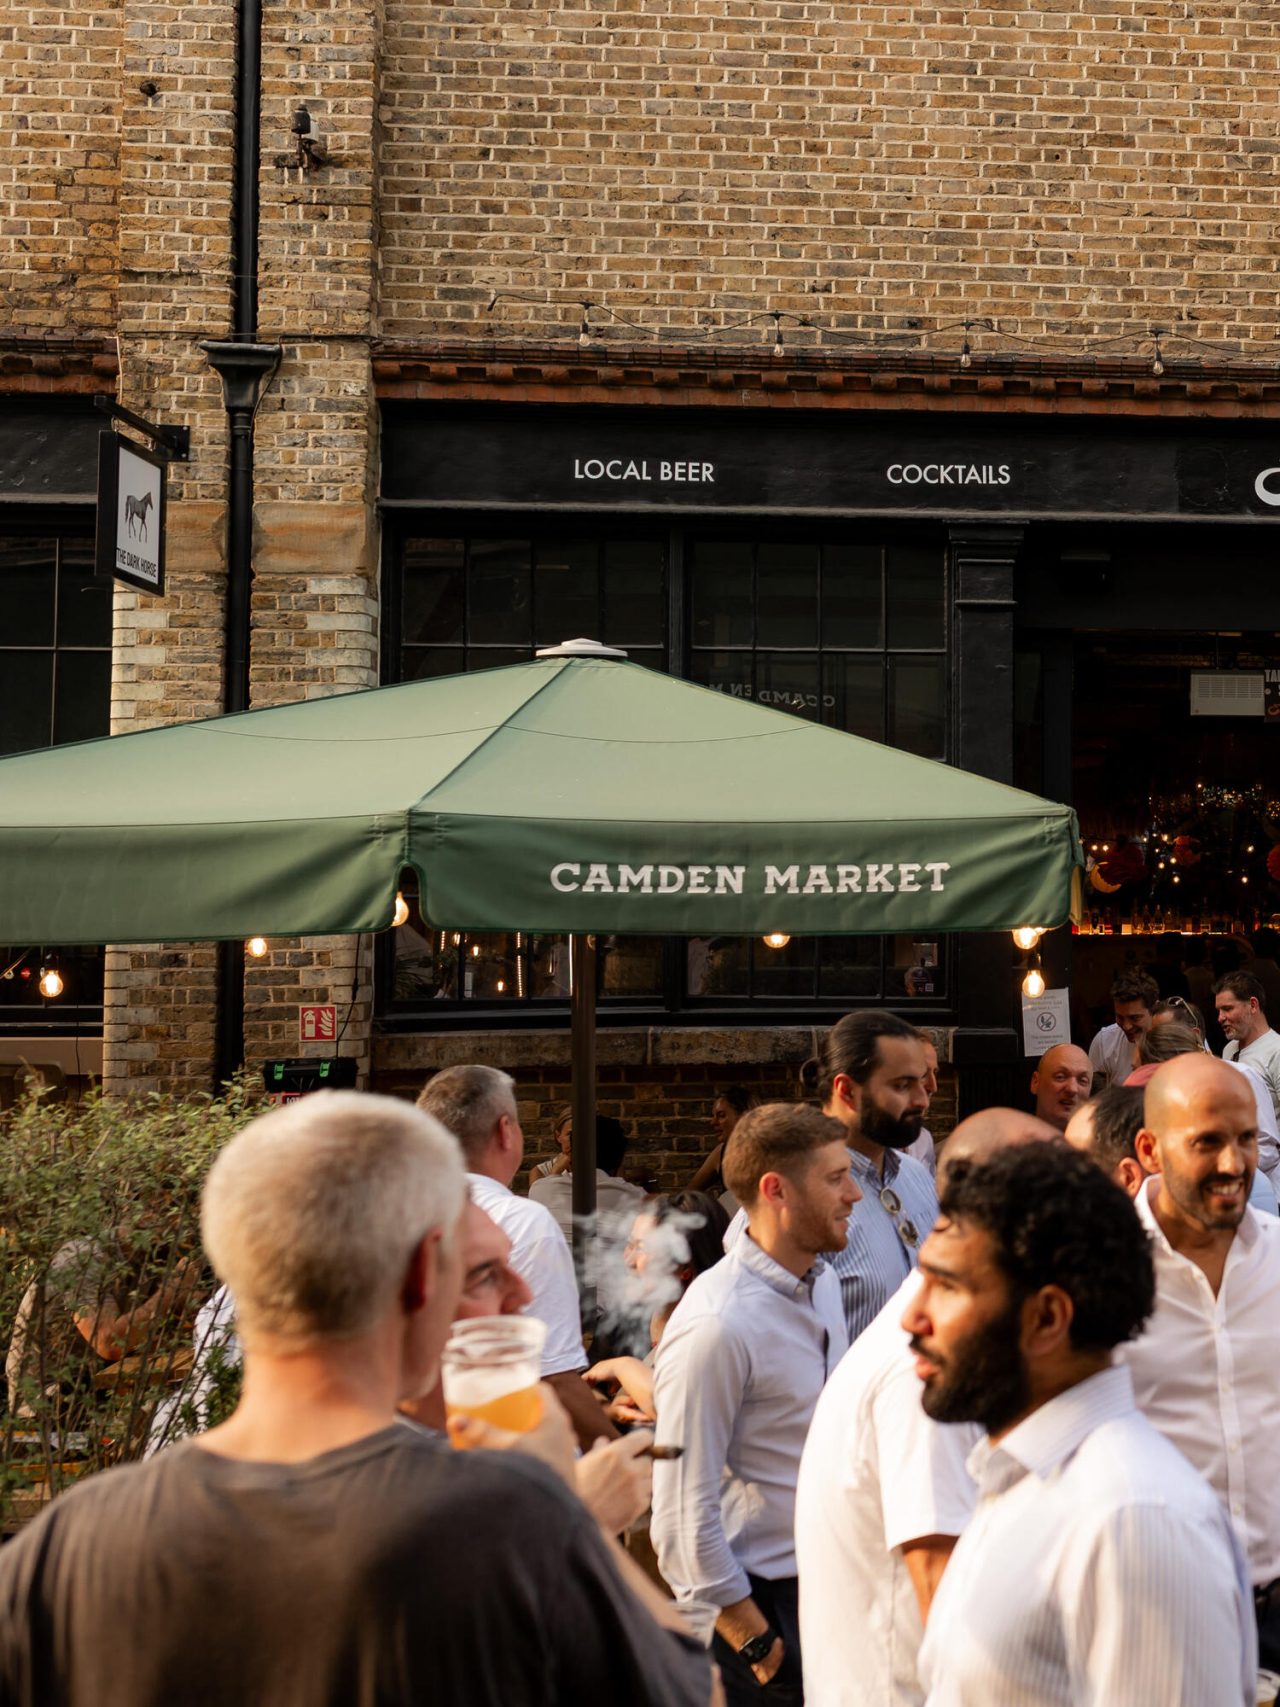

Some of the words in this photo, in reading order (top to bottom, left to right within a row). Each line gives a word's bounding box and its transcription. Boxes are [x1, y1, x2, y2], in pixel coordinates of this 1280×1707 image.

[574, 458, 652, 481] LOCAL
[659, 461, 715, 483] BEER
[886, 463, 1011, 485] COCKTAILS
[116, 546, 126, 566] THE
[127, 551, 140, 571] DARK
[140, 558, 157, 578] HORSE
[550, 863, 746, 894] CAMDEN
[764, 862, 951, 894] MARKET
